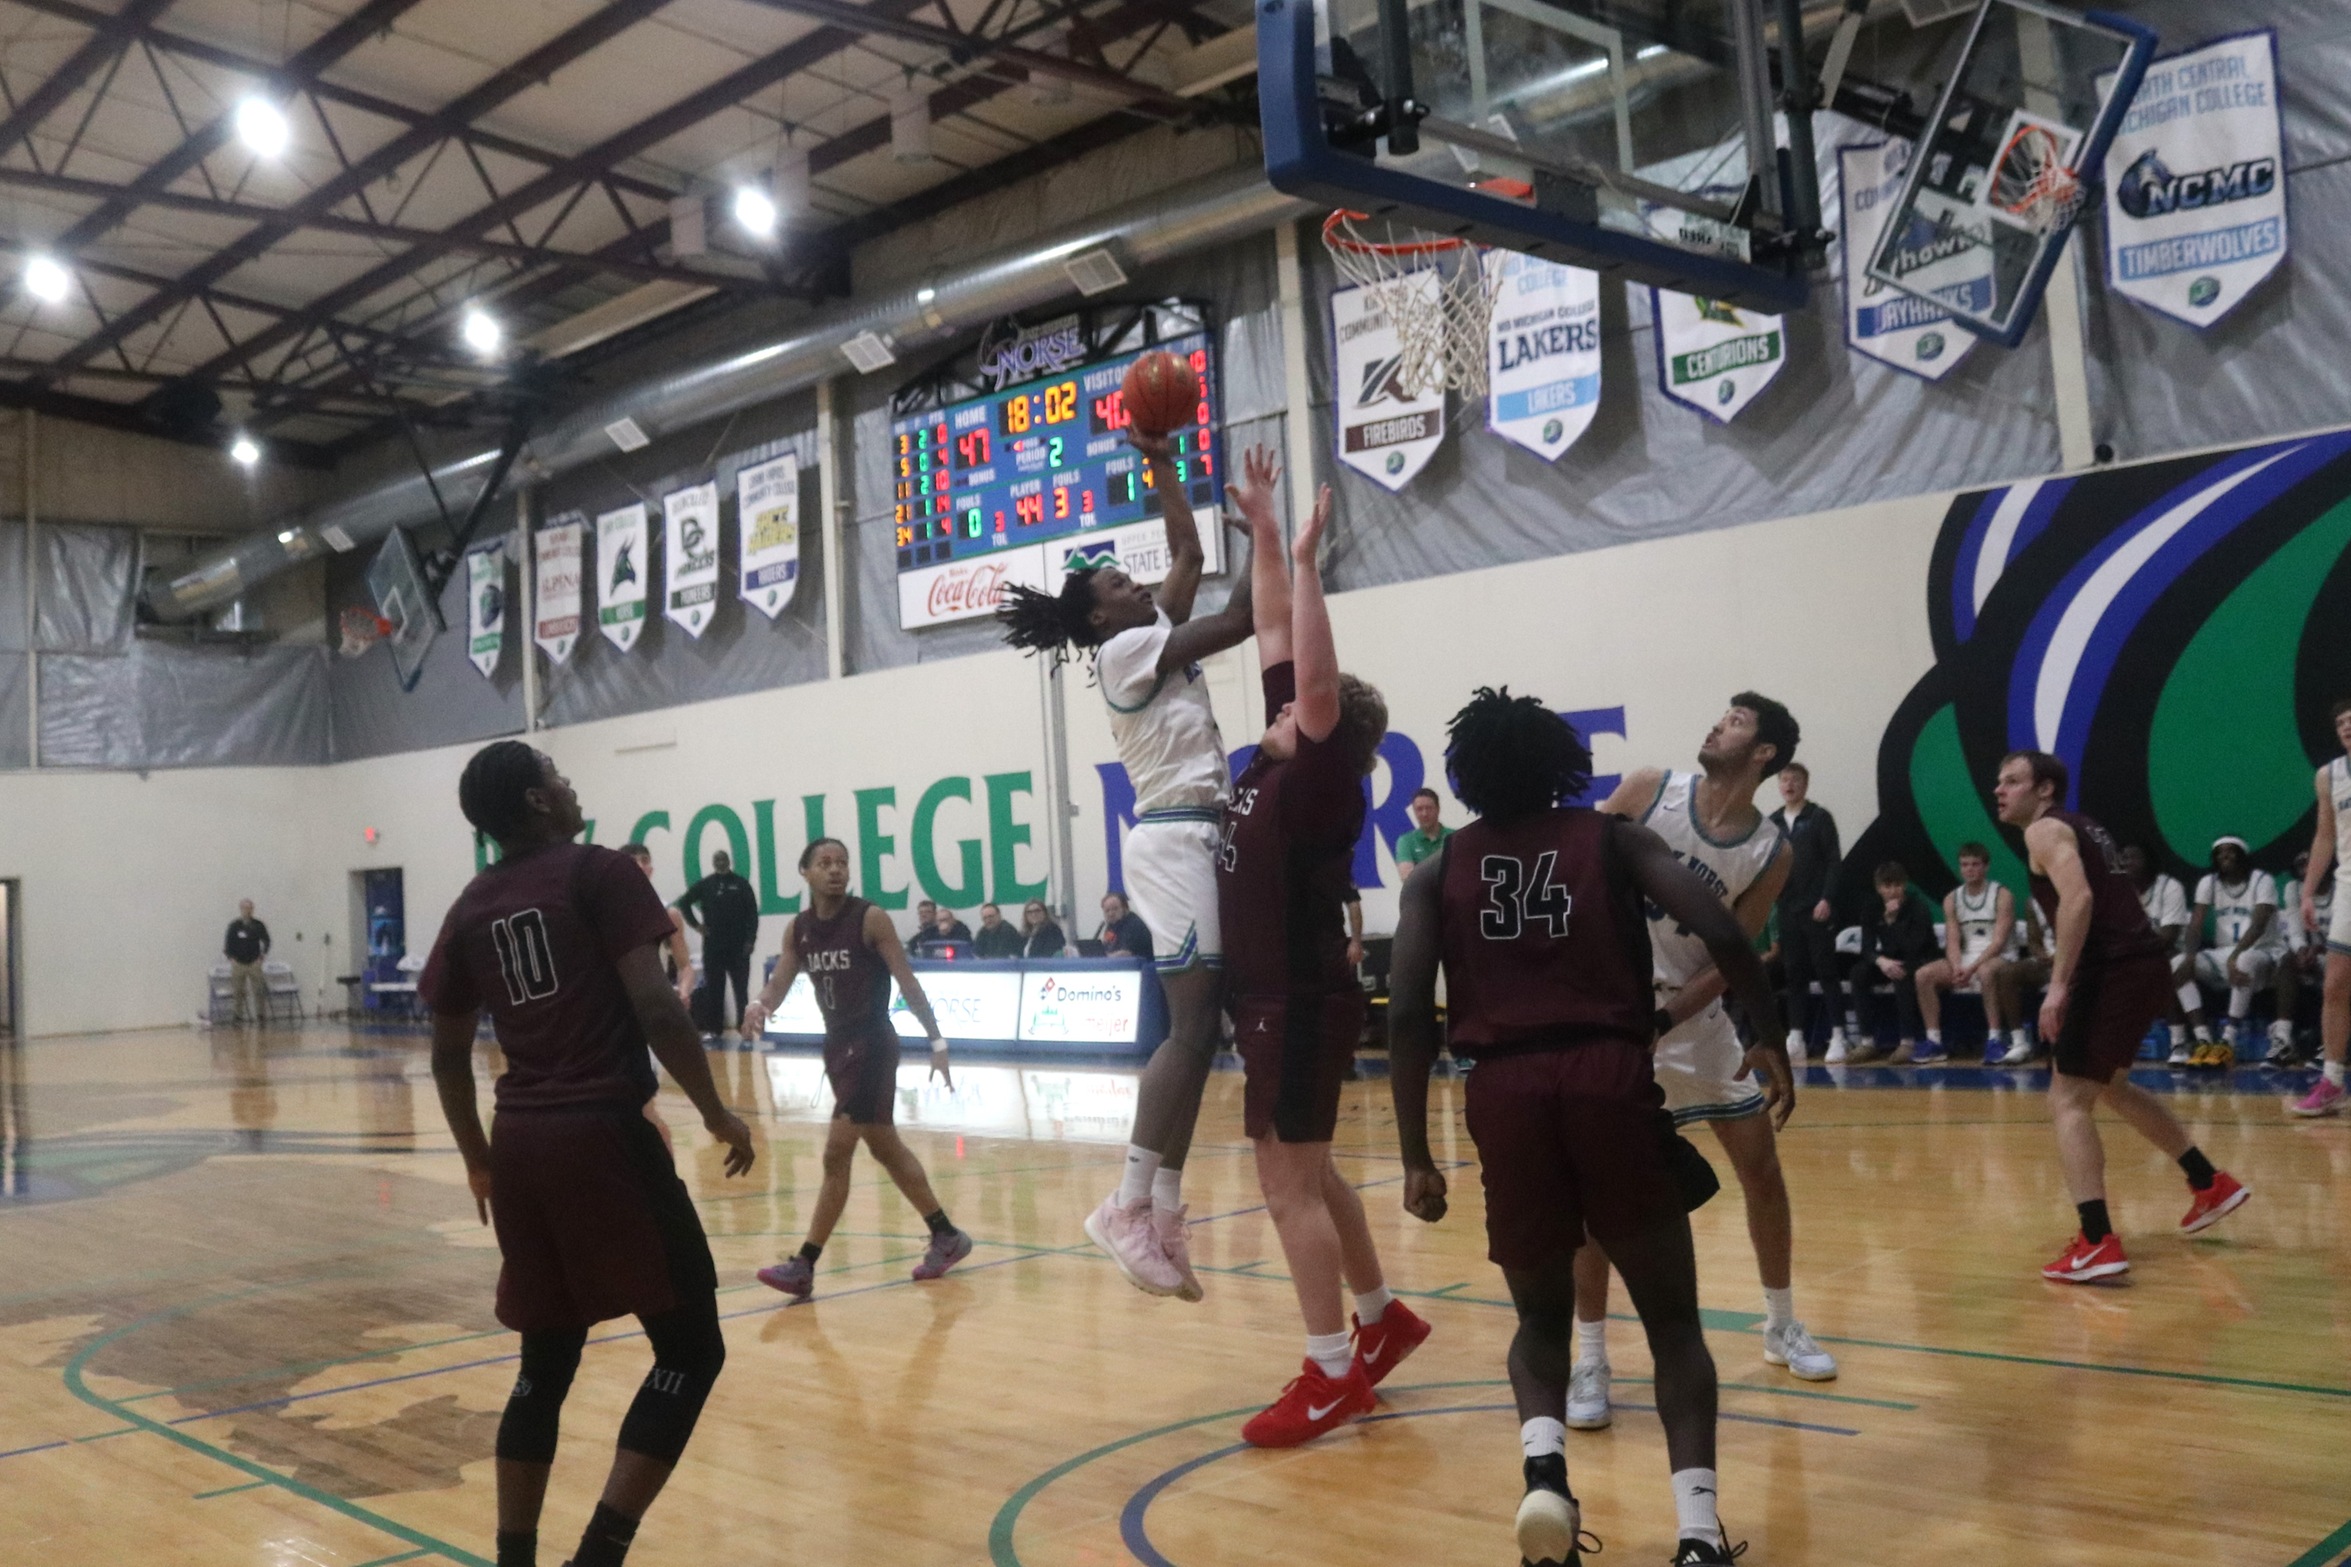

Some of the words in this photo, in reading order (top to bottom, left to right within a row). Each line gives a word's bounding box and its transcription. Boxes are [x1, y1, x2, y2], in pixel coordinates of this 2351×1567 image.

[2195, 83, 2267, 115] COLLEGE
[2147, 157, 2276, 213] NCMC
[2123, 221, 2276, 276] TIMBERWOLVES
[981, 326, 1089, 392] NORSE
[1499, 319, 1597, 373] LAKERS
[1686, 336, 1770, 379] CENTURIONS
[955, 405, 986, 430] HOME
[1007, 381, 1077, 434] 18:02
[918, 429, 928, 450] 2
[1362, 414, 1427, 449] FIREBIRDS
[959, 427, 991, 468] 47
[1016, 446, 1047, 467] PERIOD
[1049, 437, 1064, 468] 2
[1087, 437, 1117, 458] BONUS
[968, 467, 995, 488] BONUS
[1053, 468, 1081, 488] FOULS
[1105, 456, 1135, 476] FOULS
[1010, 478, 1042, 499] PLAYER
[1127, 470, 1136, 502] 1
[955, 493, 981, 512] FOULS
[1016, 493, 1044, 526] 44
[1053, 486, 1070, 520] 3
[1082, 489, 1094, 513] 3
[896, 524, 913, 548] 34
[968, 507, 982, 539] 0
[994, 510, 1005, 533] 3
[1123, 548, 1163, 575] STATE
[1481, 850, 1572, 940] 34
[491, 907, 559, 1006] 10
[806, 949, 852, 973] JACKS
[1057, 985, 1122, 1002] Domino's
[648, 1368, 685, 1395] XII
